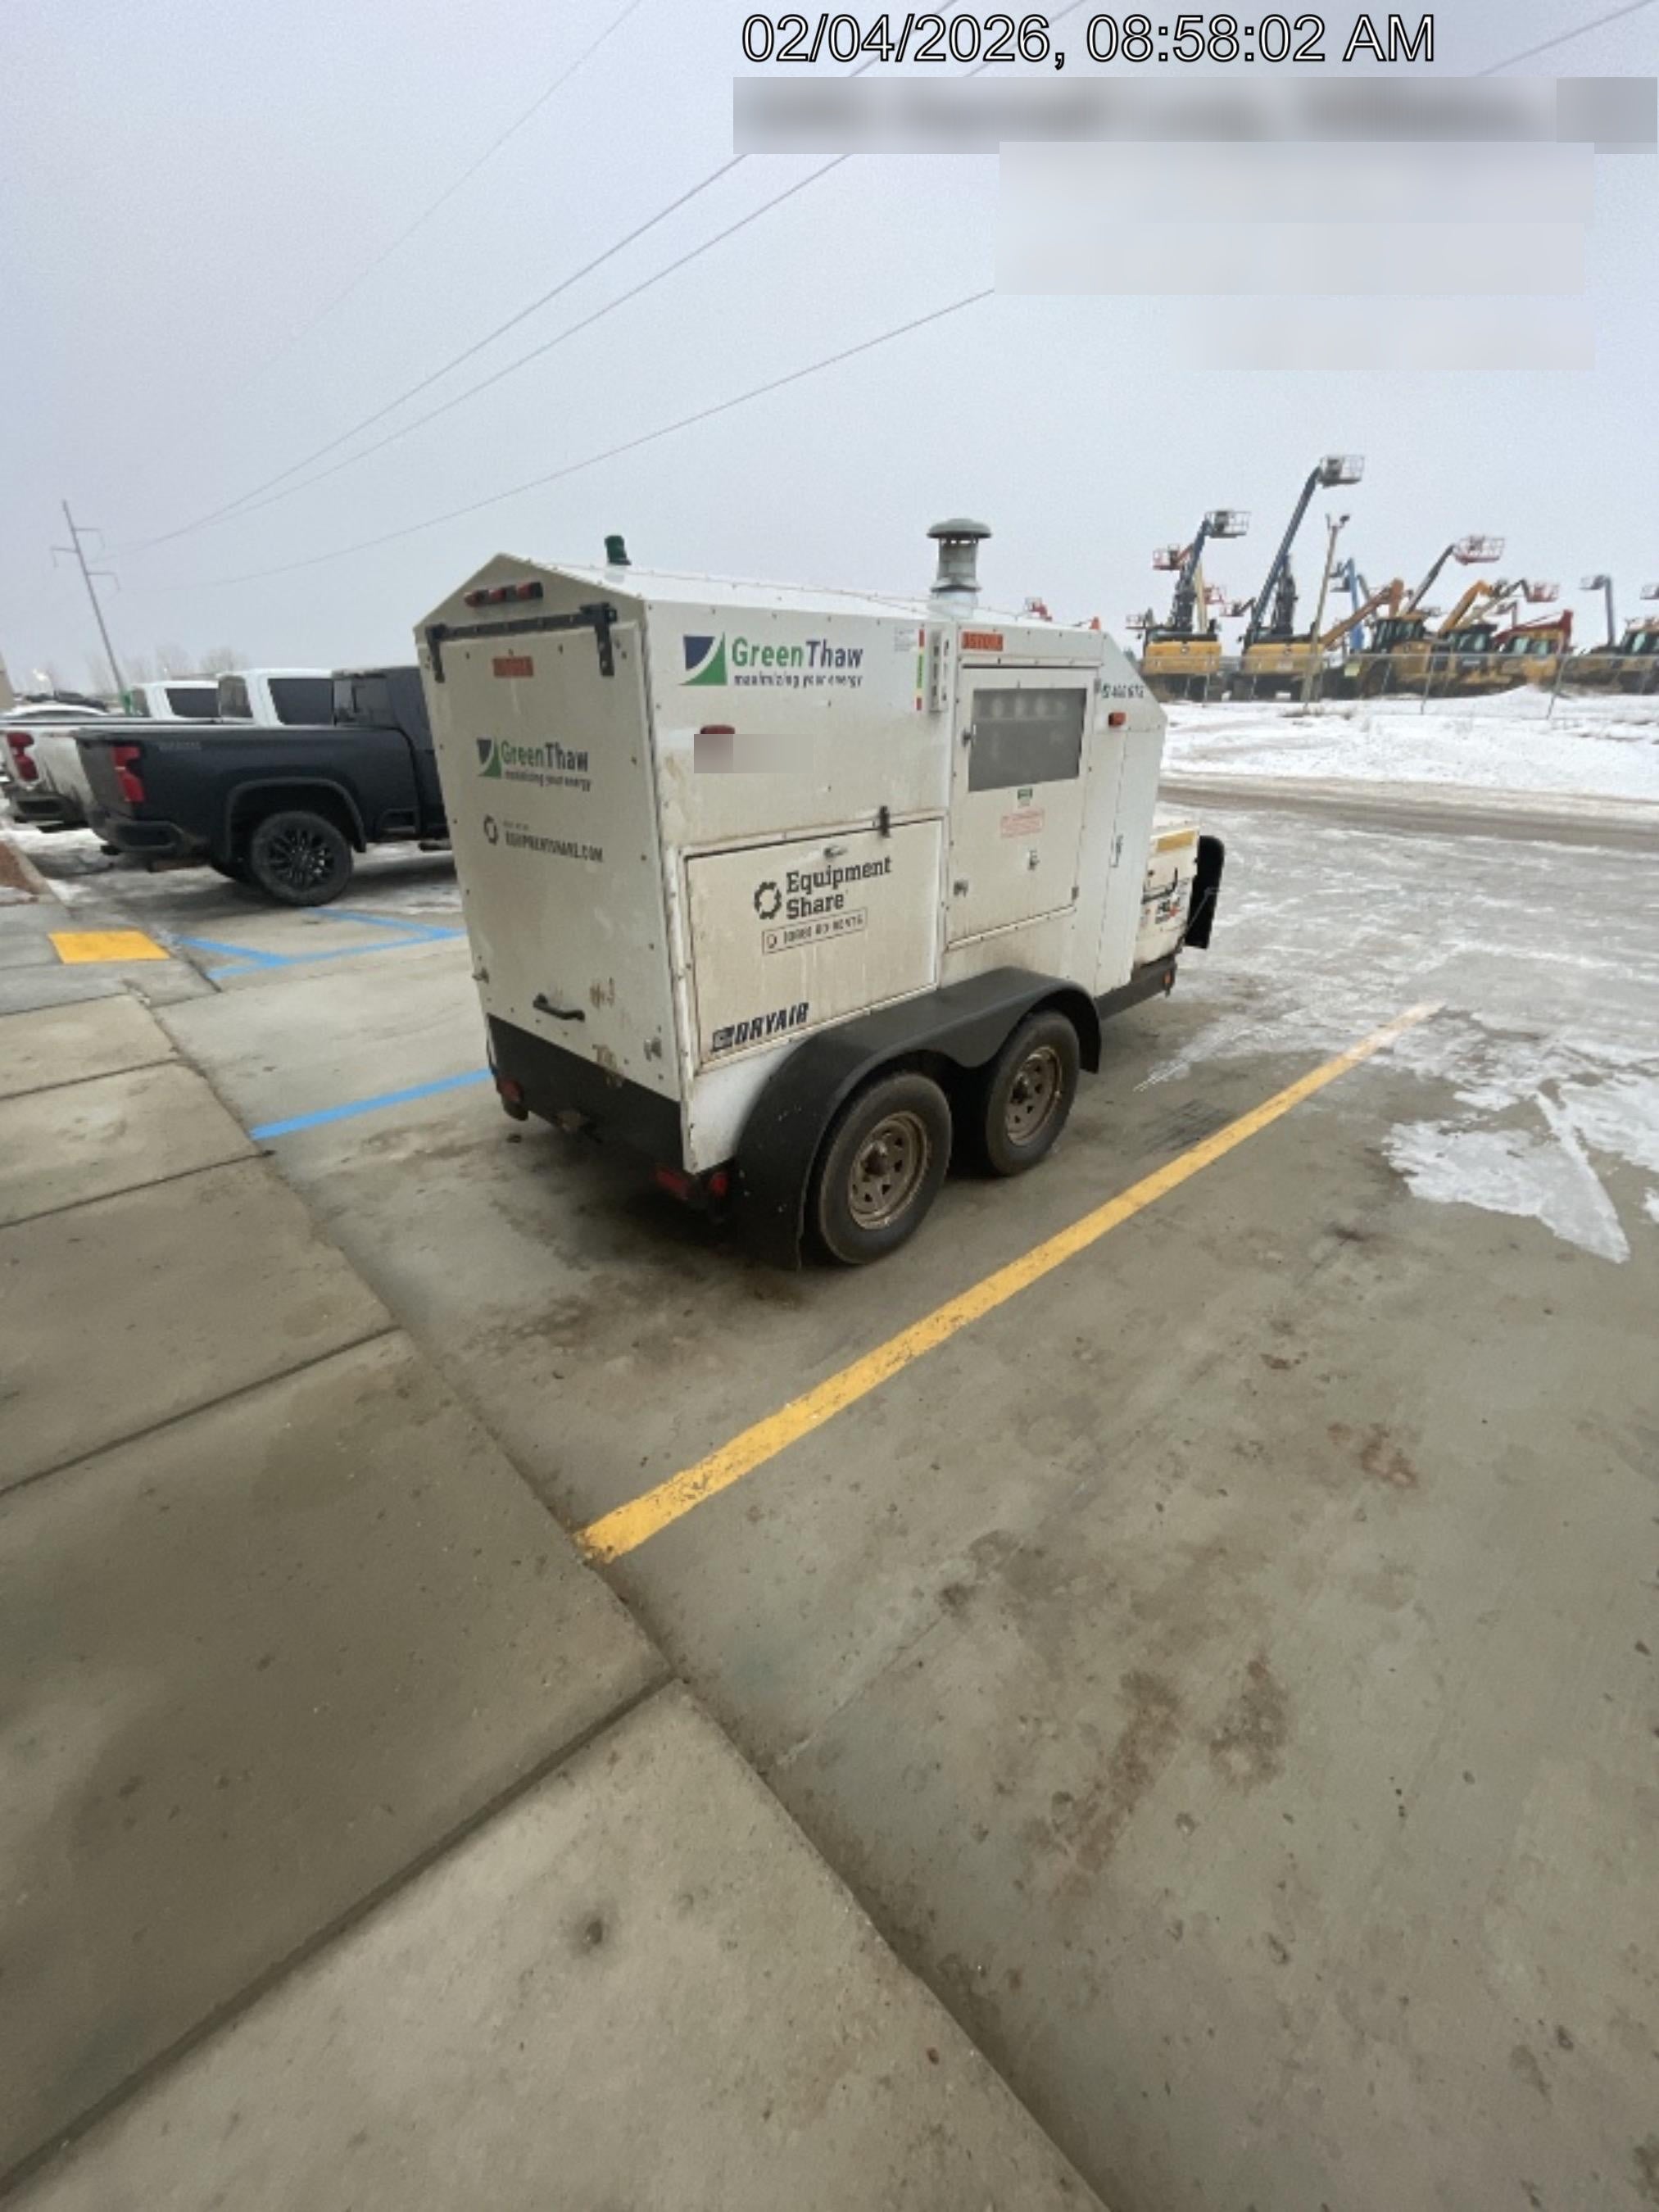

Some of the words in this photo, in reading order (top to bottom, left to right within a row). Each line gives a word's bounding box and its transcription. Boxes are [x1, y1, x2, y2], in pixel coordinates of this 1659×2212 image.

[732, 636, 863, 669] GreenThaw
[501, 740, 589, 772] GreenThaw
[786, 855, 892, 895] Equipment
[786, 893, 845, 919] Share
[734, 1002, 809, 1045] DRYAIR
